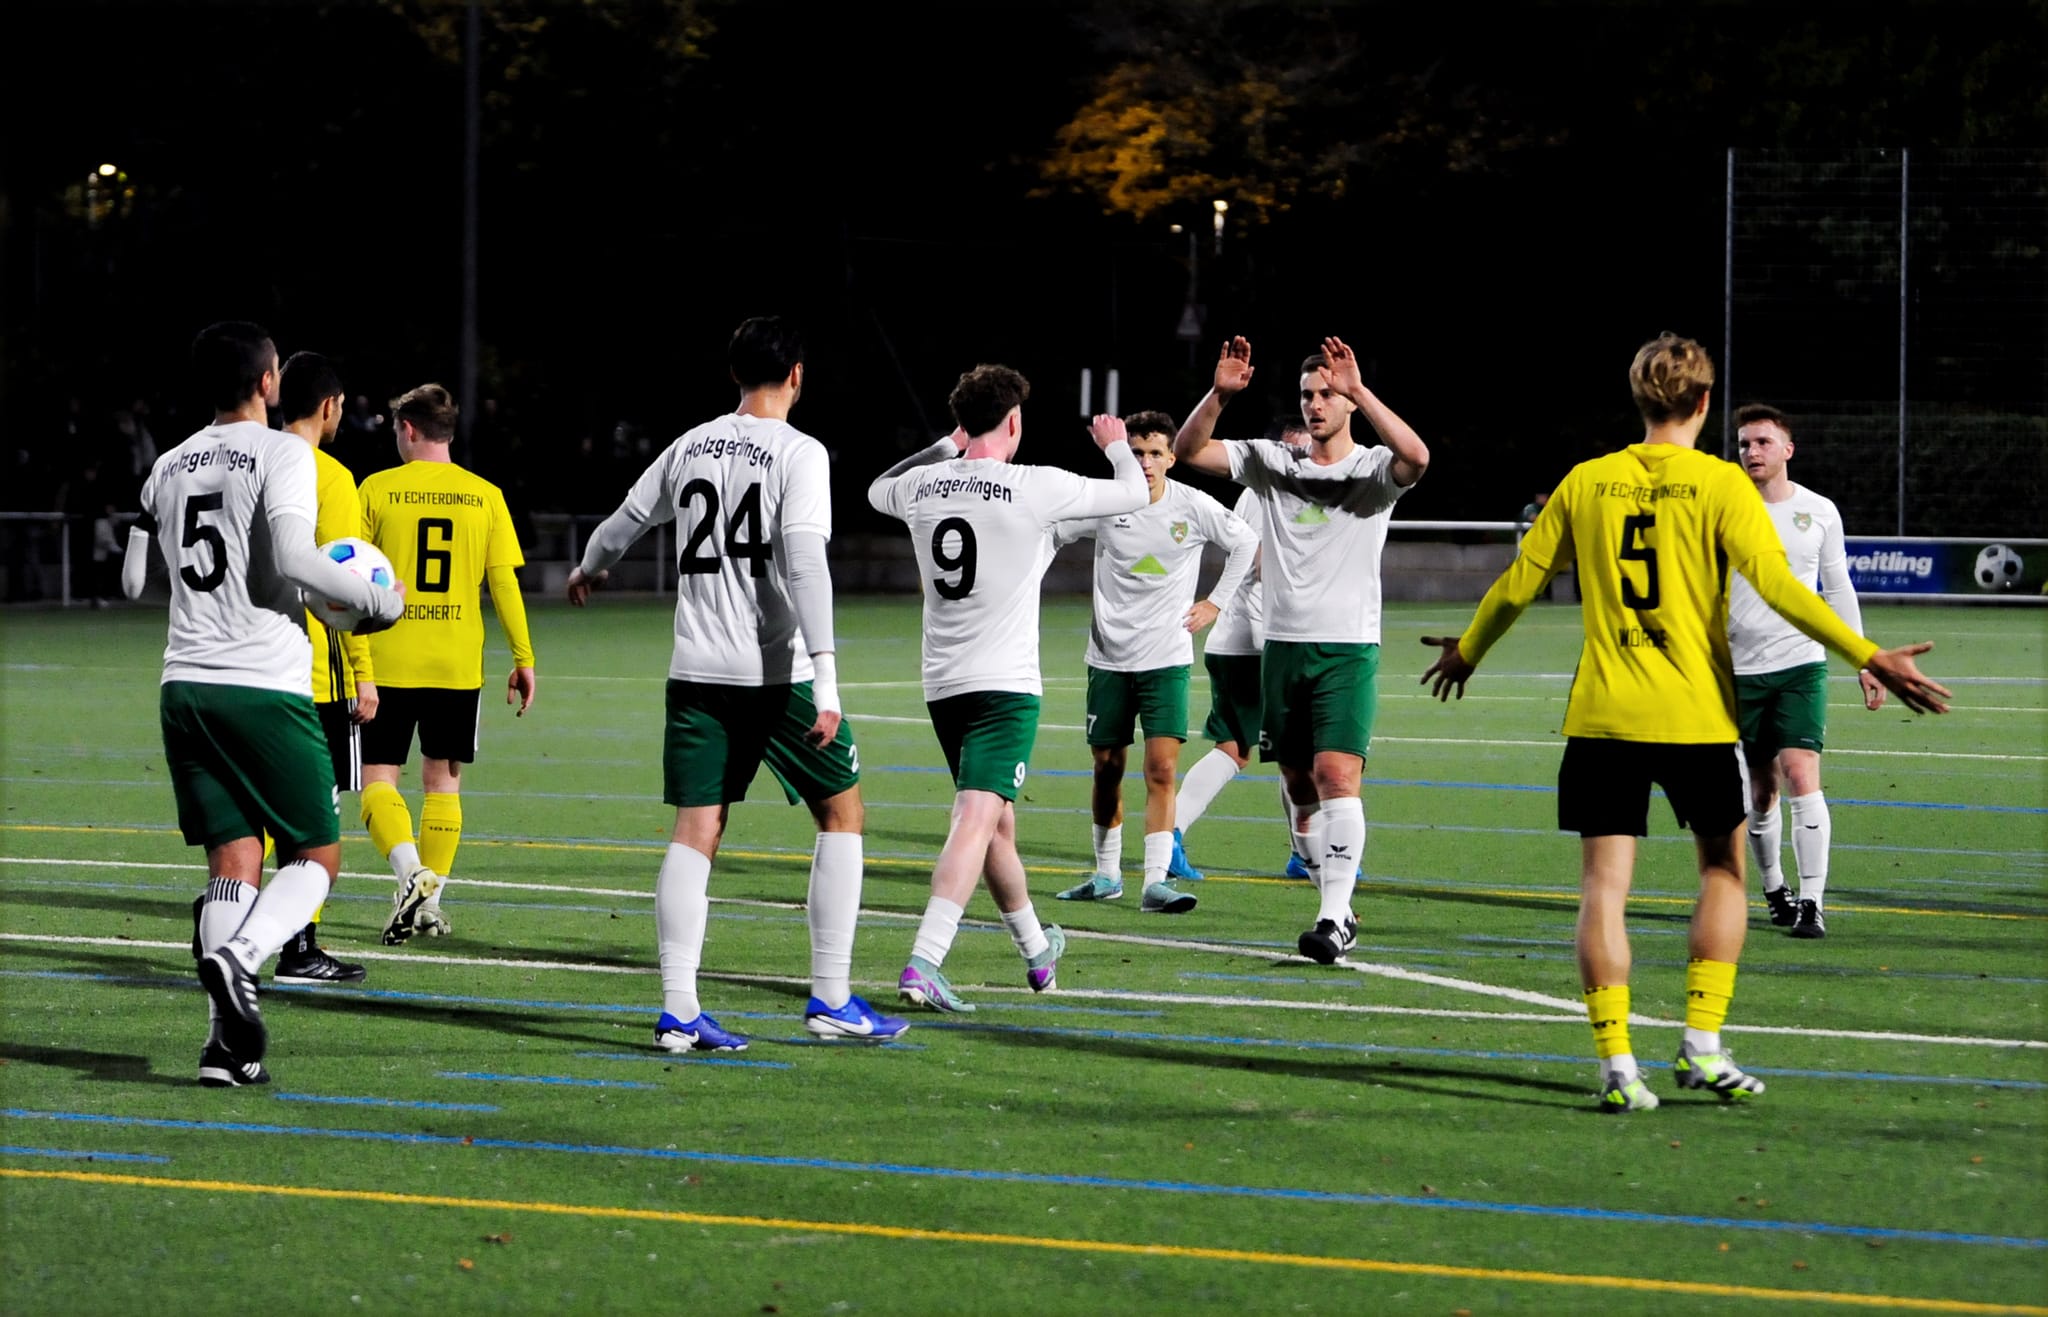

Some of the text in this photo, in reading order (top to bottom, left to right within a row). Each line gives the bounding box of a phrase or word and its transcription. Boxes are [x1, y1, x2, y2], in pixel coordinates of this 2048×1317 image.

[161, 443, 256, 482] Holzgerlingen
[683, 436, 773, 473] Holzgerlingen
[389, 491, 484, 508] TV ECHTERDINGEN
[915, 476, 1012, 503] Holzgerlingen
[179, 491, 228, 593] 5
[679, 478, 773, 578] 24
[416, 517, 453, 593] 6
[931, 517, 978, 601] 9
[1618, 514, 1660, 610] 5
[1846, 551, 1933, 578] reitling
[401, 604, 462, 621] REICHERTZ
[1087, 714, 1097, 735] 7
[1013, 761, 1026, 788] 9
